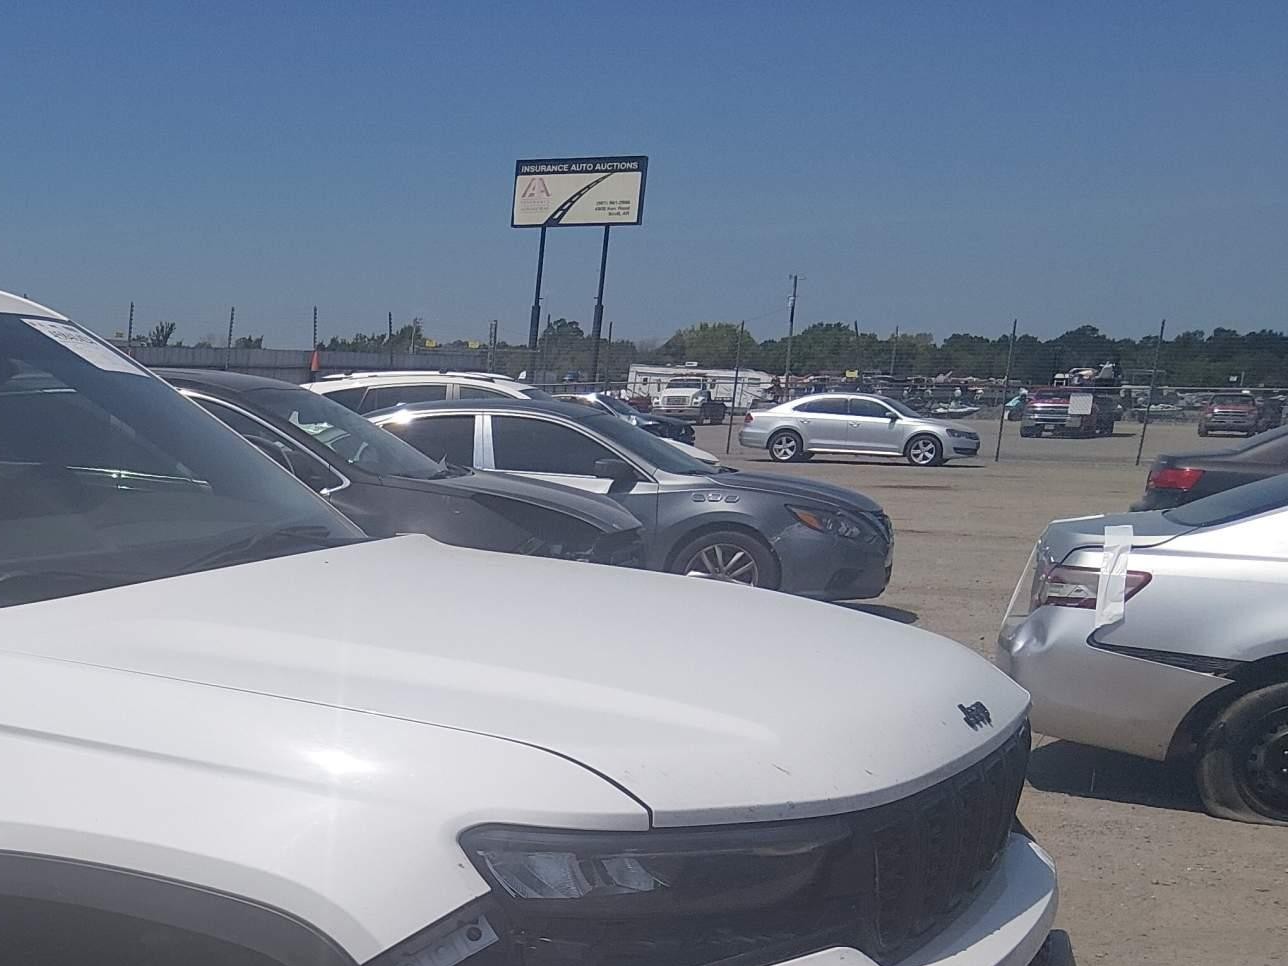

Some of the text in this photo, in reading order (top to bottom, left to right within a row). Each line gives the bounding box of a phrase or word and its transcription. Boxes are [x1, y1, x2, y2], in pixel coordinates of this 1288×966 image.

[521, 161, 639, 173] INSURANCE AUTO AUCTIONS
